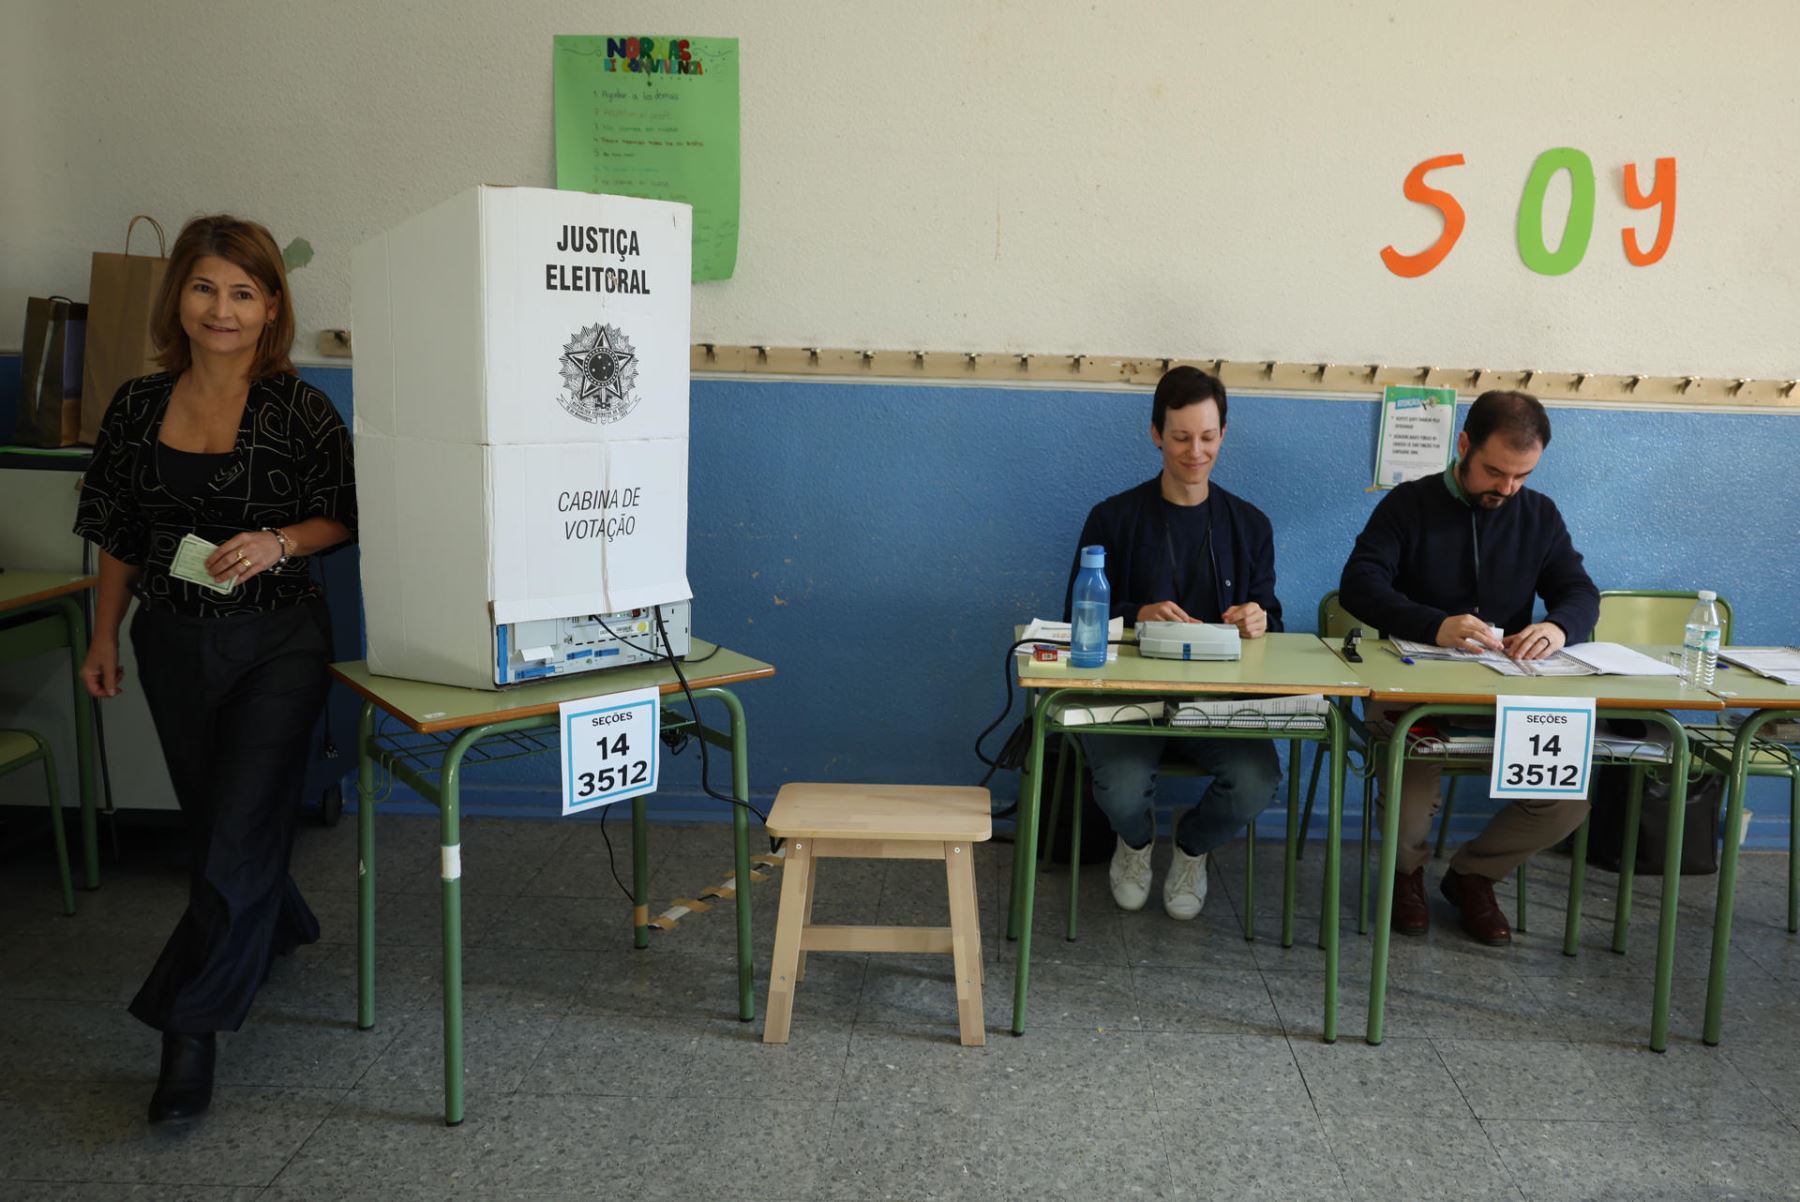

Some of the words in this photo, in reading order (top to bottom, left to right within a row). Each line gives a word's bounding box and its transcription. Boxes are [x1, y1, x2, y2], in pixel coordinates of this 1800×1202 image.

[607, 36, 691, 61] NORMAS
[1380, 147, 1676, 278] SOY
[557, 225, 640, 262] JUSTIÇA
[546, 264, 650, 294] ELEITORAL
[558, 489, 618, 512] CABINA
[622, 487, 641, 508] DE
[565, 513, 636, 543] VOTAÇÃO
[592, 712, 633, 727] SEÇÕES
[1526, 714, 1567, 725] SEÇÕES
[597, 733, 630, 760] 14
[1529, 734, 1562, 756] 14
[578, 760, 647, 796] 3512
[1506, 763, 1578, 786] 3512
